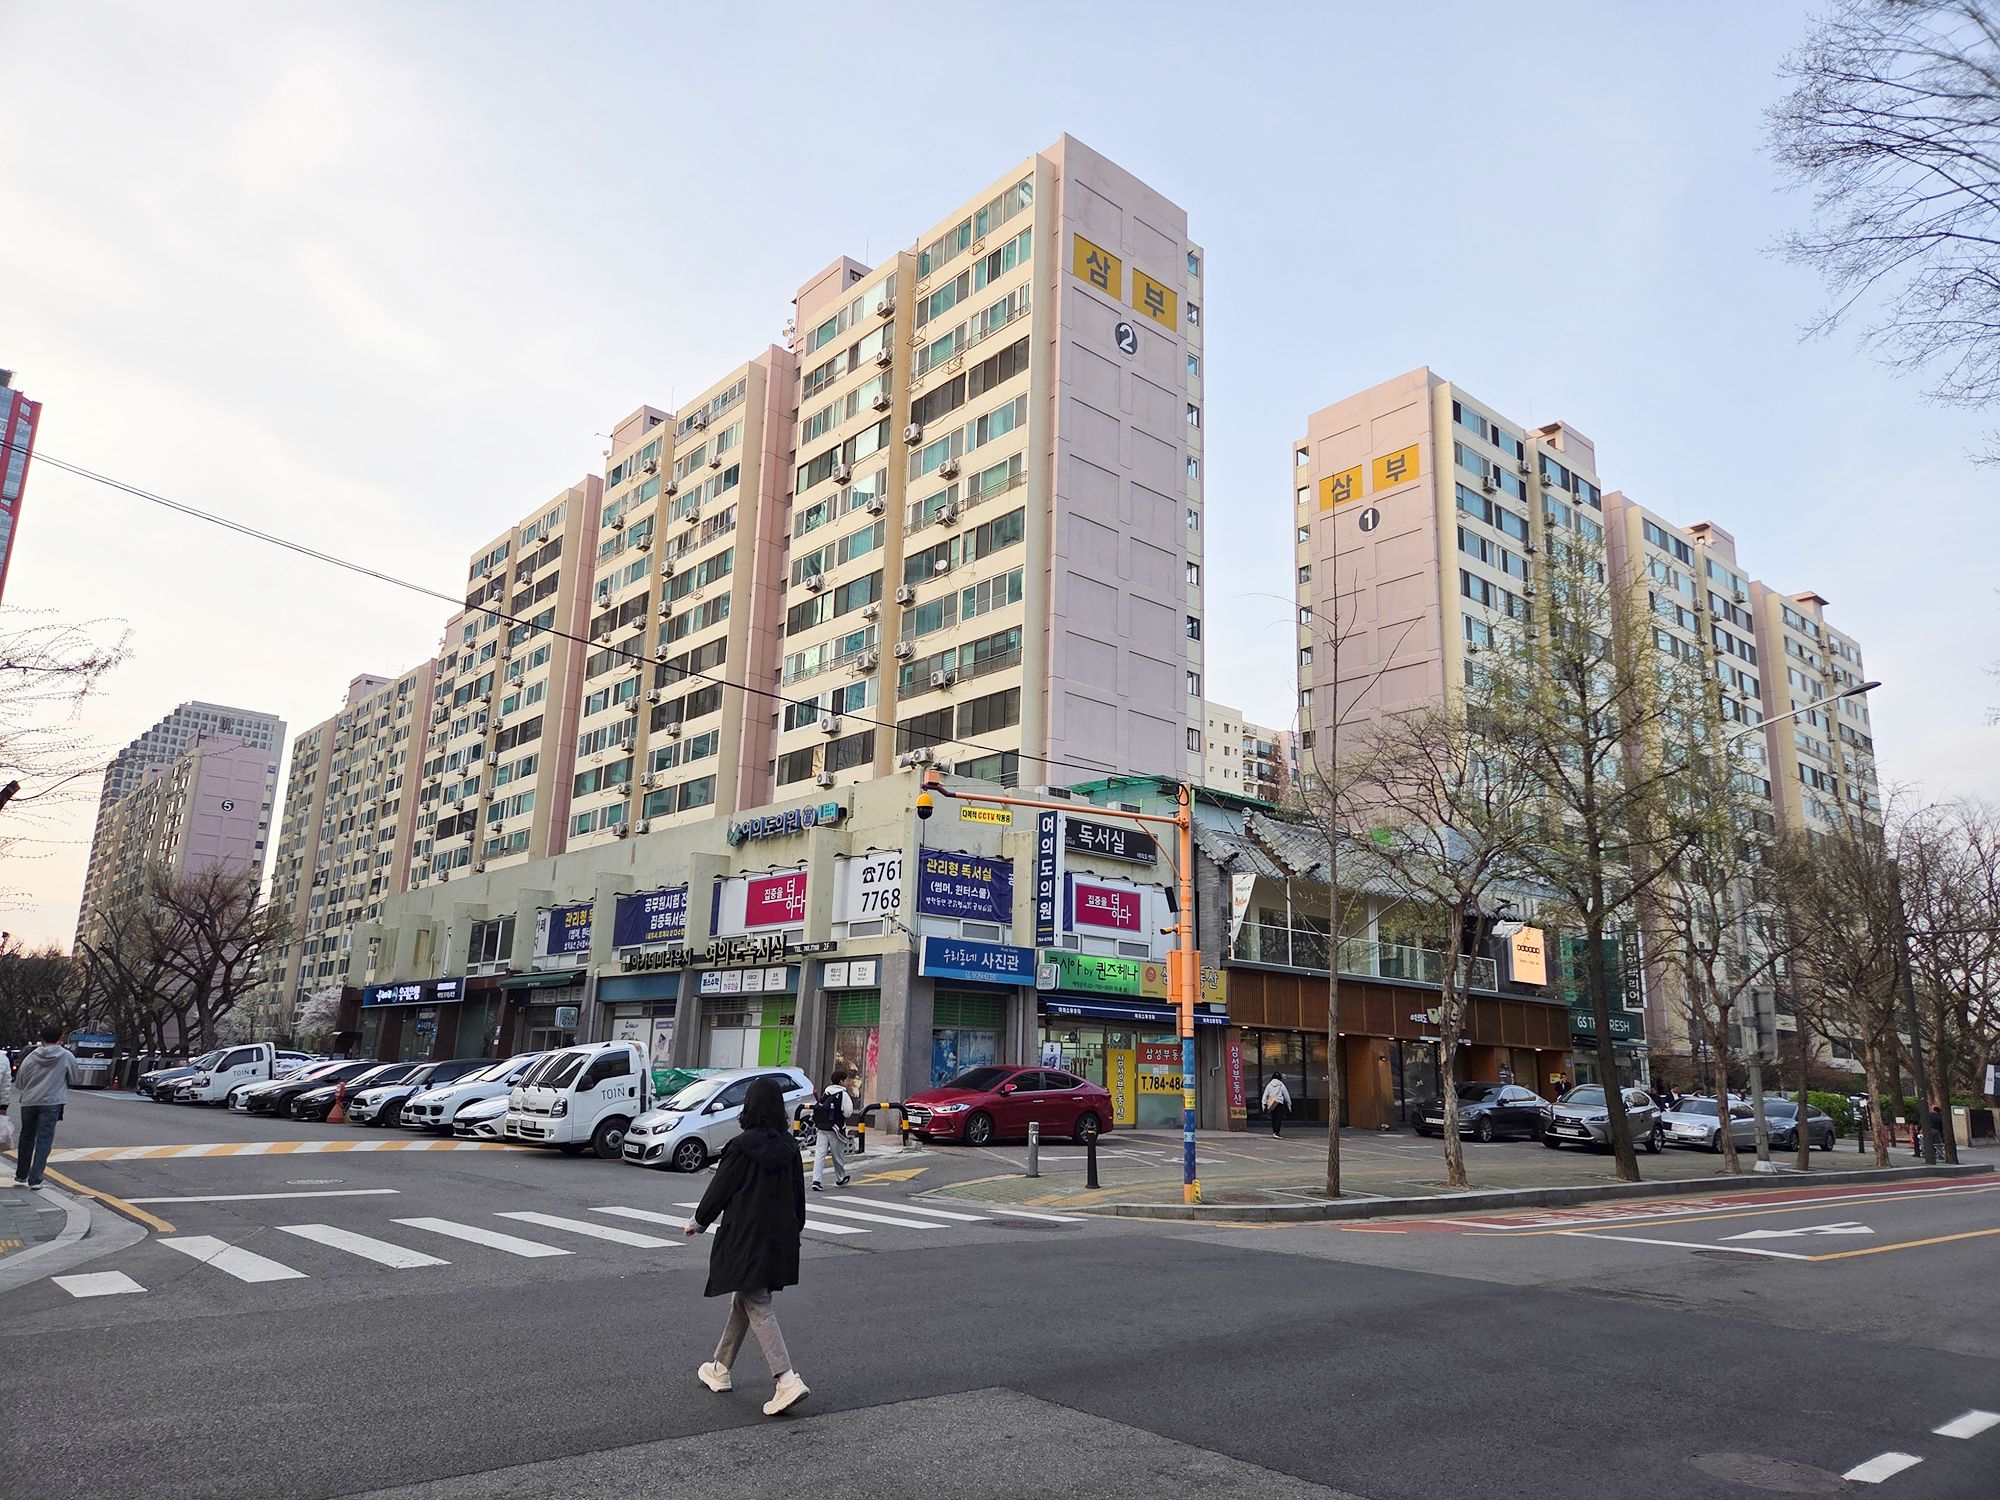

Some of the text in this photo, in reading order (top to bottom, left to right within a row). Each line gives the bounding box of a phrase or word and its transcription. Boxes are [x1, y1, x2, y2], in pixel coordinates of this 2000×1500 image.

[1086, 250, 1165, 318] 삼 부
[1119, 324, 1134, 354] 2
[1331, 454, 1407, 503] 삼 부
[742, 809, 800, 842] 여의도의원
[978, 811, 996, 821] CCTV
[1079, 824, 1125, 854] 독서실
[926, 858, 958, 877] 관리형
[962, 863, 992, 882] 독서실
[1040, 815, 1055, 920] 여의도의원
[644, 893, 680, 913] 공무원시험
[764, 886, 783, 901] 집중을
[862, 887, 901, 912] 7768
[1087, 894, 1107, 907] 집중을
[705, 935, 786, 966] 여의도독서실
[823, 942, 830, 951] 2F
[943, 948, 1019, 971] 우리동네 사진관
[1084, 967, 1094, 977] by
[1577, 1016, 1587, 1029] GS
[1609, 1019, 1630, 1032] RESH
[1145, 1048, 1183, 1061] 삼성부동
[1231, 1046, 1242, 1105] 삼성부동산
[601, 1086, 625, 1101] TOIN
